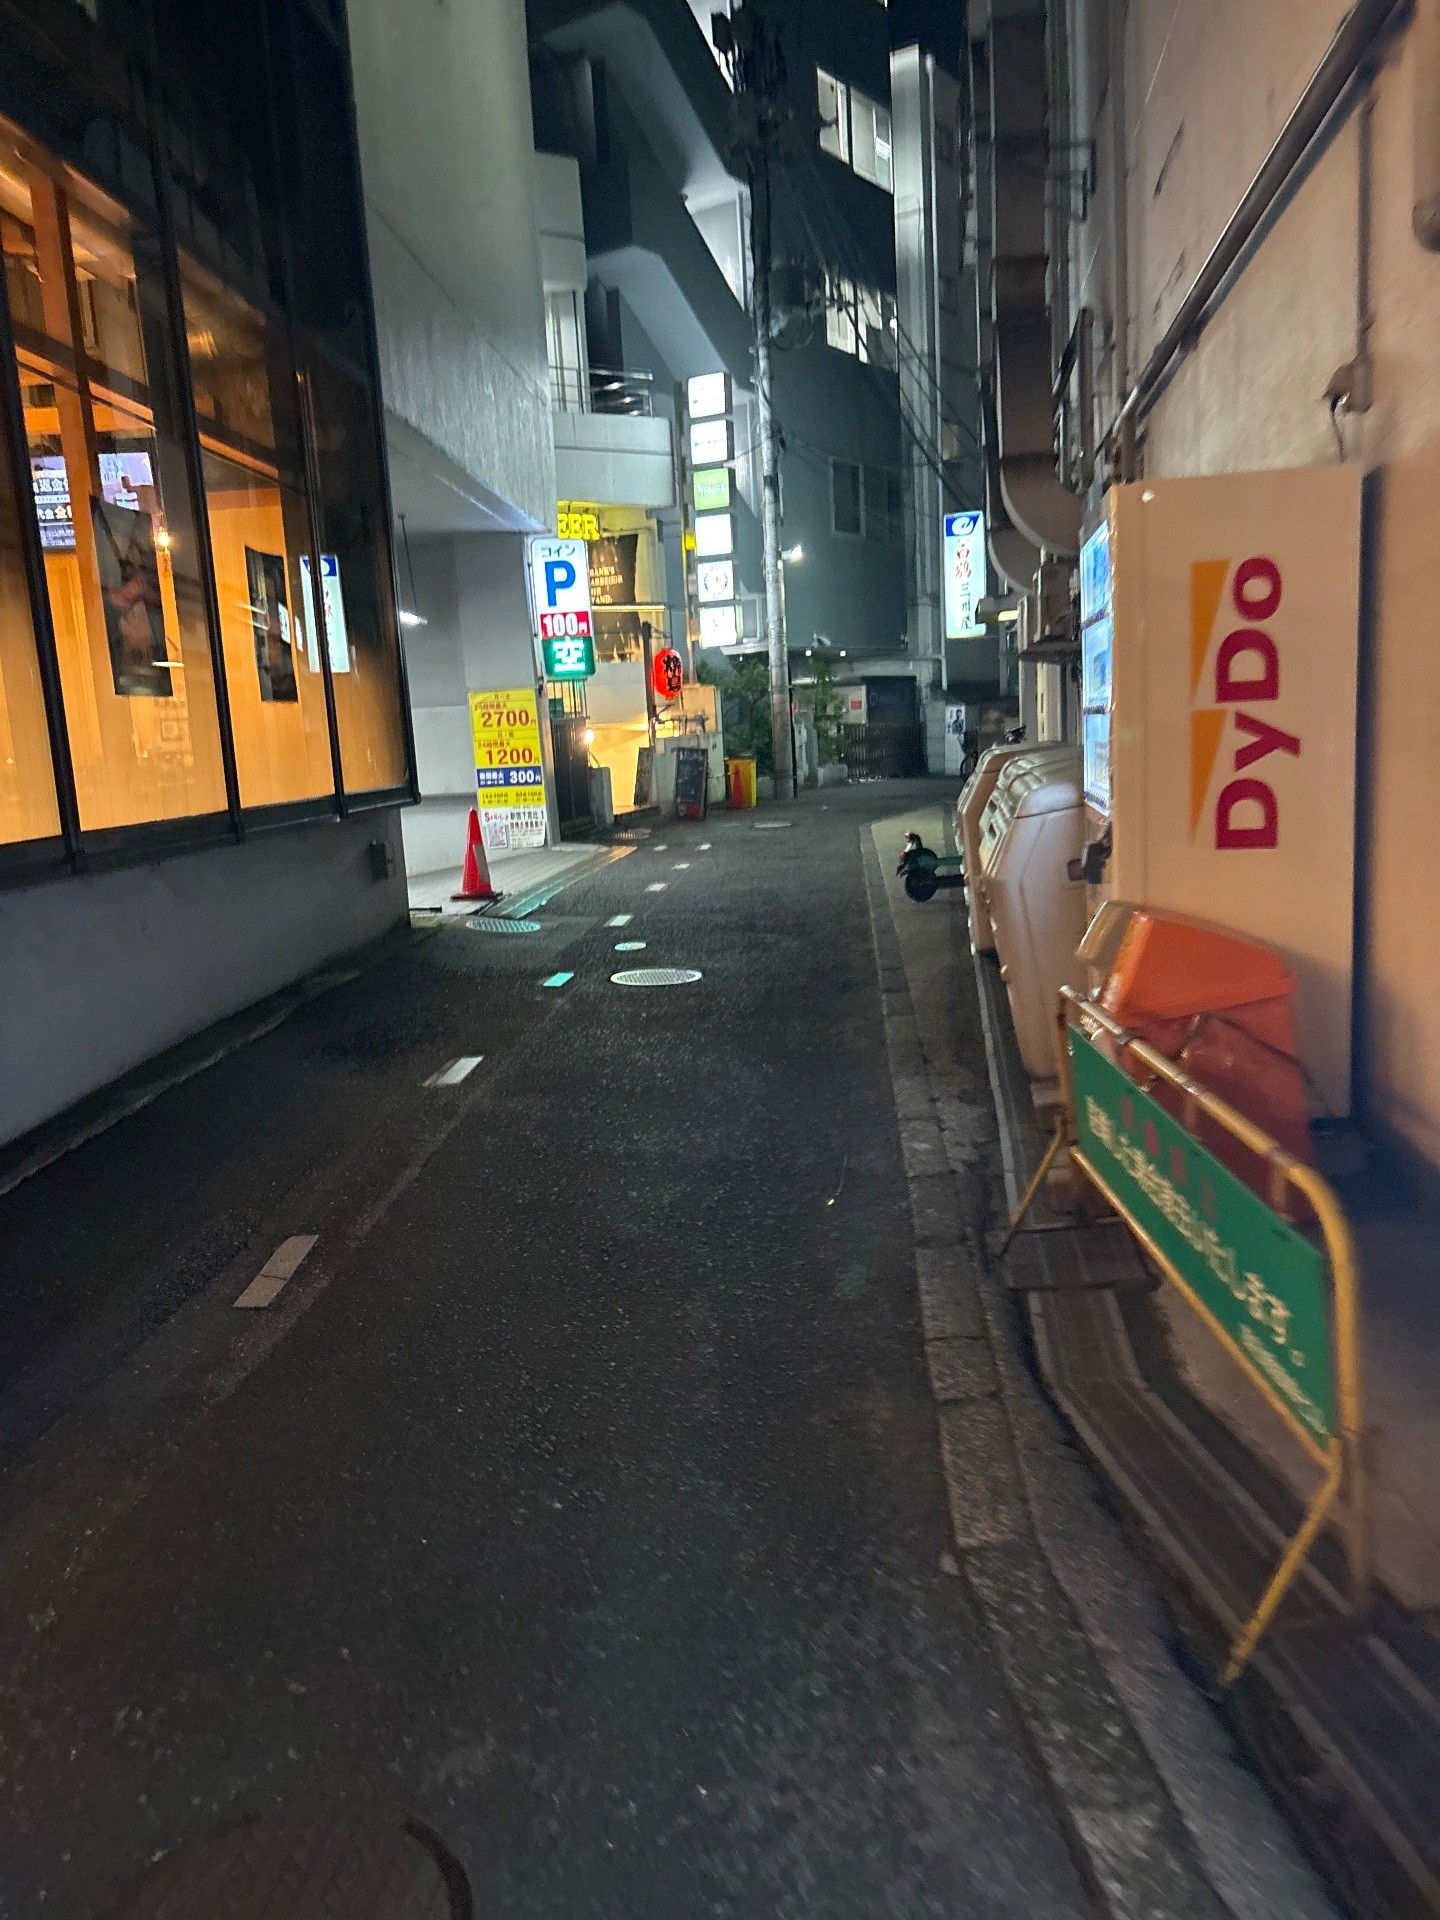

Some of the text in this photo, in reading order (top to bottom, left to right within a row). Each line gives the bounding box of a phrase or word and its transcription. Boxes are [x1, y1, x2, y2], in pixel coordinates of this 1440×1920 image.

[540, 545, 576, 558] コイン
[544, 560, 576, 608] P
[542, 613, 588, 637] 100円
[552, 637, 586, 673] 空
[1215, 556, 1301, 850] DyDo
[481, 710, 537, 728] 2700円
[486, 747, 540, 765] 1200円
[509, 770, 541, 784] 300円
